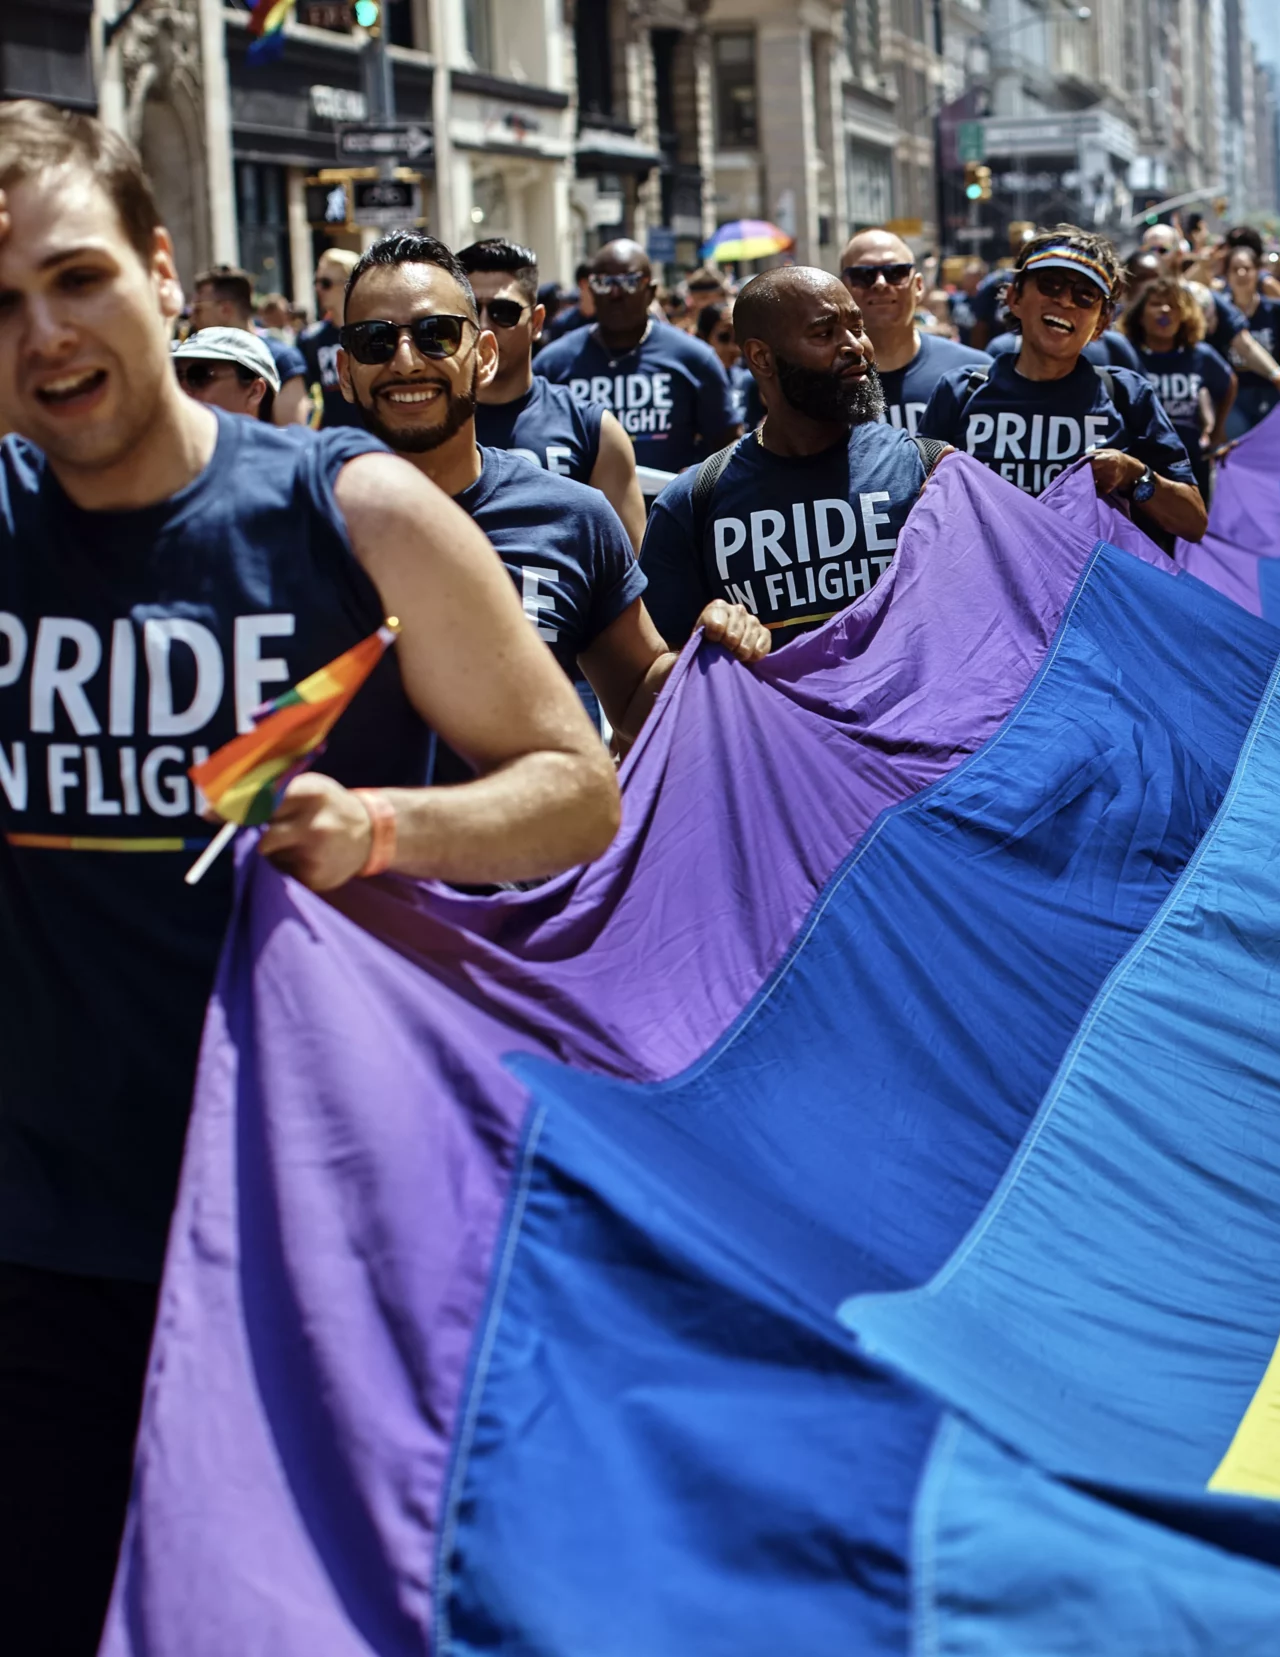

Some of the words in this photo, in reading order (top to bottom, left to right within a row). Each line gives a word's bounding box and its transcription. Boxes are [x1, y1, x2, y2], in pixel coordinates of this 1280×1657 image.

[569, 373, 674, 409] PRIDE
[617, 408, 673, 433] IGHT.
[966, 412, 1109, 461] PRIDE
[1000, 462, 1074, 493] FLIG
[714, 491, 897, 580] PRIDE
[765, 556, 894, 611] FLIGHT
[0, 741, 28, 812] N
[47, 744, 214, 818] FLIG
